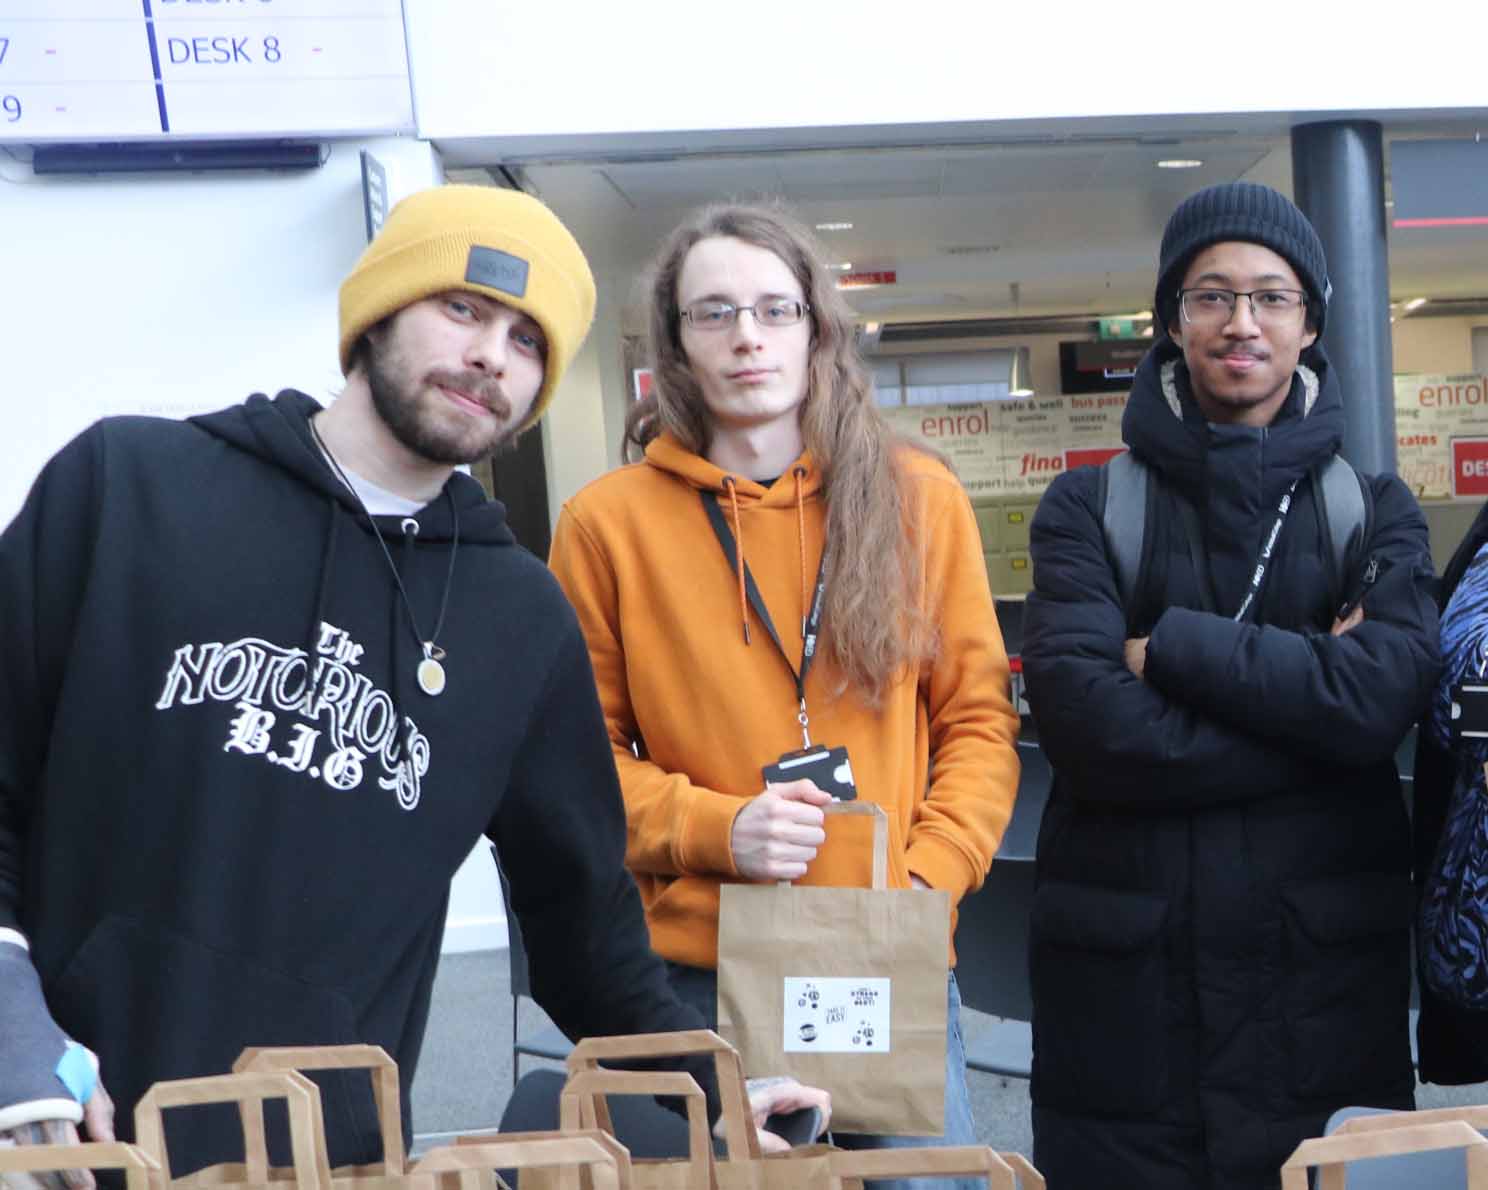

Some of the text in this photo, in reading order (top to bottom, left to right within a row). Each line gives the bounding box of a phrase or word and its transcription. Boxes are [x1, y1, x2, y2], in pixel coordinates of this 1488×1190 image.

[167, 36, 252, 65] DESK
[263, 35, 282, 64] 8
[2, 94, 22, 122] 9
[1071, 397, 1093, 409] bus
[1418, 375, 1488, 407] enrol
[921, 408, 989, 438] enrol
[320, 621, 365, 666] The
[155, 637, 430, 810] NOTORIOUS
